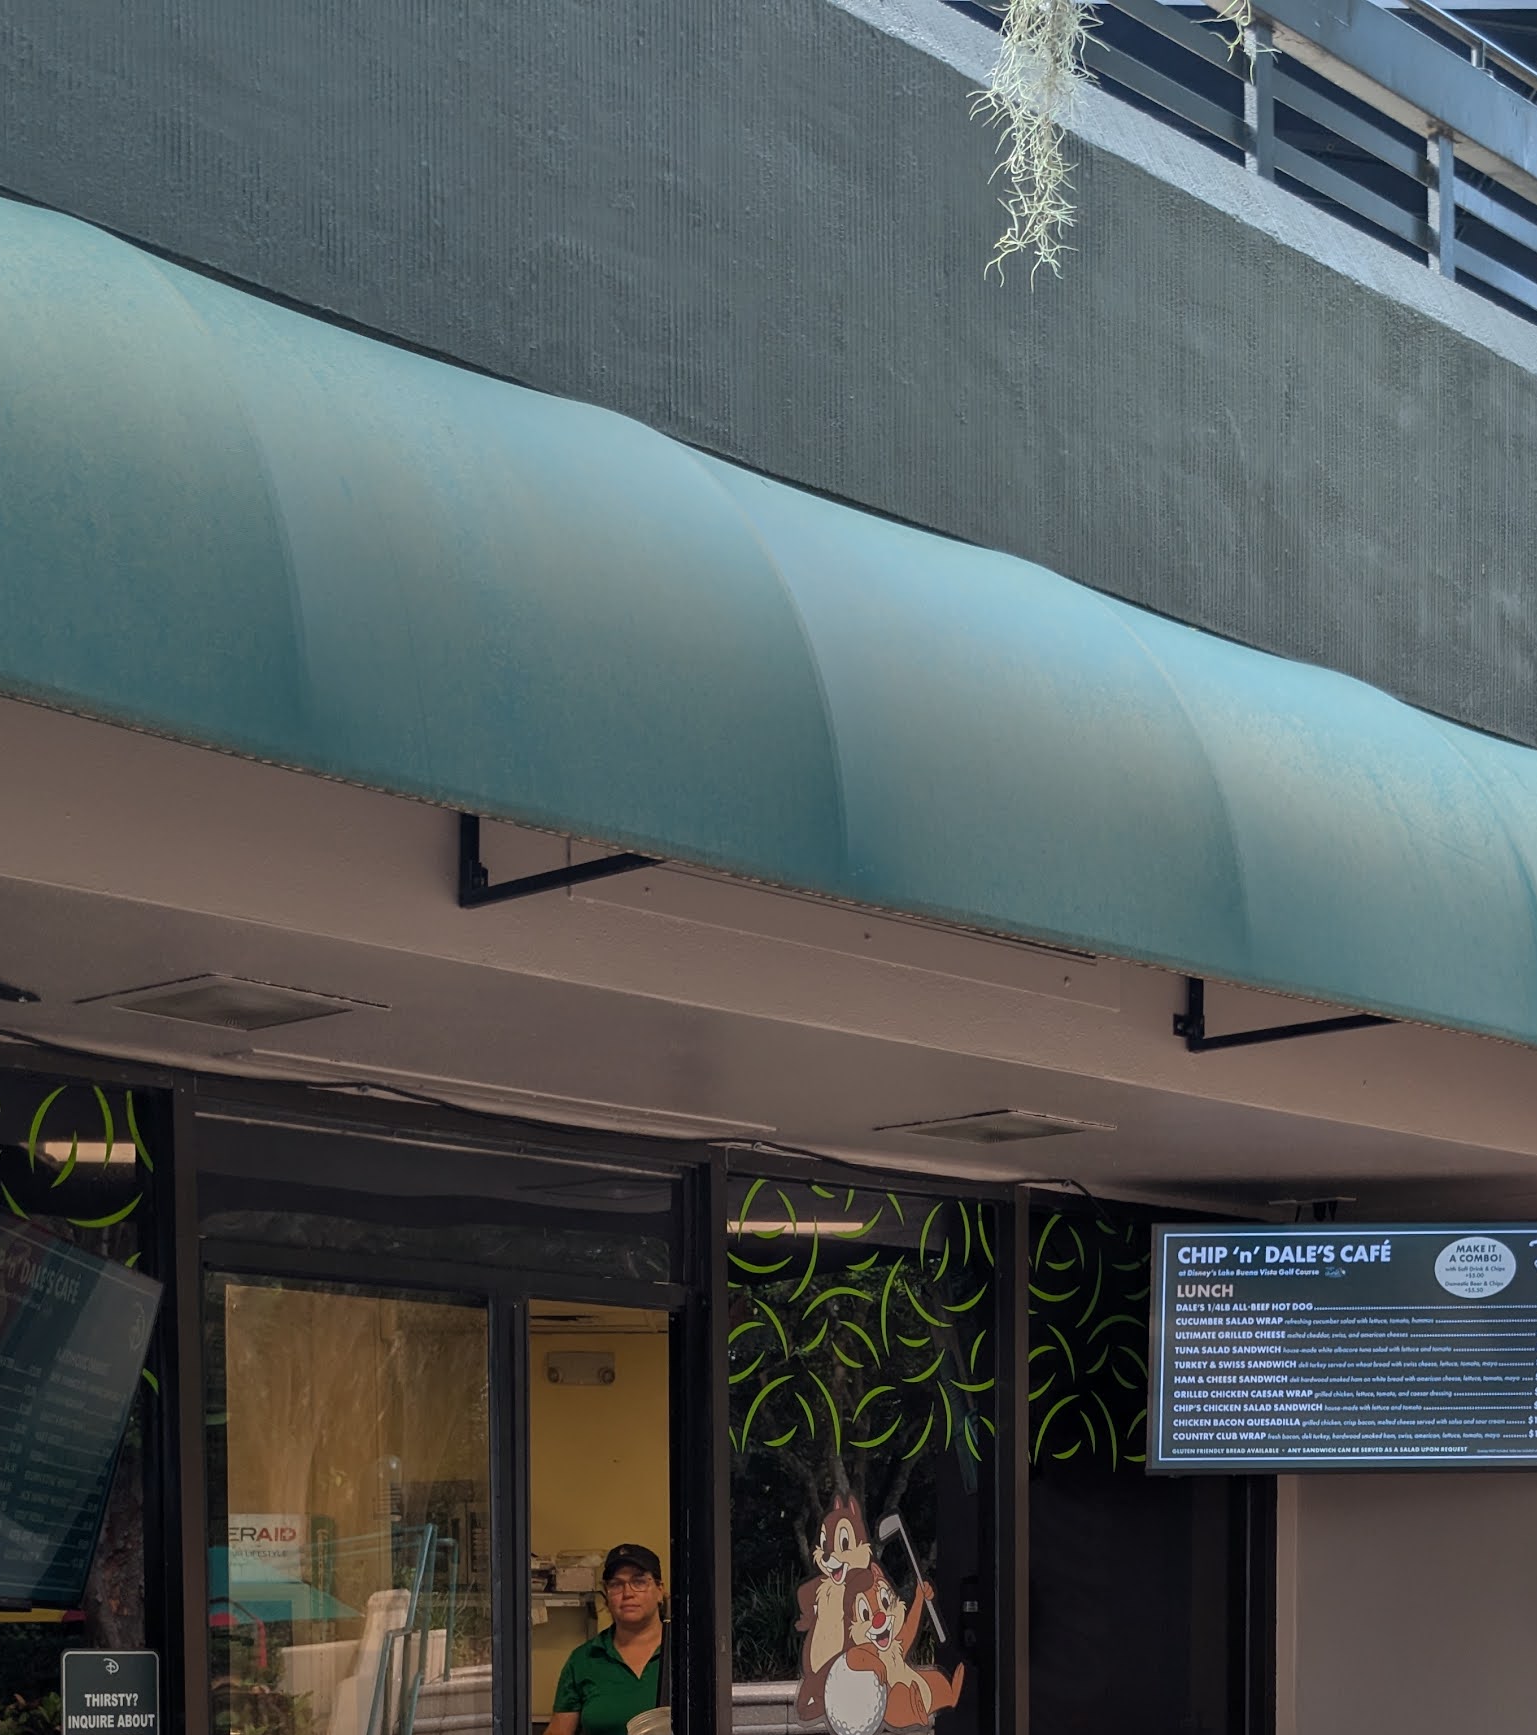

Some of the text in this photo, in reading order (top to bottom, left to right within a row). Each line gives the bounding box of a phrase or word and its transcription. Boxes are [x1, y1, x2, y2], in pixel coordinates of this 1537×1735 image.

[1178, 1247, 1227, 1264] CHIP
[1265, 1245, 1334, 1263] DALE'S
[1340, 1239, 1391, 1262] CAFÉ
[1456, 1245, 1497, 1253] MAKE IT
[1449, 1254, 1502, 1263] A COMBO!
[1279, 1268, 1294, 1276] Golf
[1177, 1284, 1234, 1298] LUNCH
[1176, 1304, 1205, 1312] DALE'S
[1207, 1303, 1230, 1313] 1/4LB
[1272, 1303, 1290, 1311] HOT
[1292, 1303, 1313, 1311] DOG
[1226, 1317, 1254, 1325] SALAD
[1256, 1317, 1283, 1325] WRAP
[1176, 1331, 1216, 1339] ULTIMATE
[1218, 1331, 1253, 1339] GRILLED
[1255, 1331, 1286, 1339] CHEESE
[1175, 1346, 1199, 1354] TUNA
[1202, 1346, 1230, 1354] SALAD
[1232, 1346, 1281, 1354] SANDWICH
[1175, 1361, 1207, 1369] TURKEY
[1210, 1361, 1216, 1369] &
[1218, 1361, 1245, 1369] SWISS
[1247, 1360, 1296, 1368] SANDWICH
[1174, 1376, 1196, 1384] HAM
[1197, 1376, 1204, 1384] &
[1239, 1375, 1288, 1383] SANDWICH
[1174, 1390, 1208, 1398] GRILLED
[1210, 1390, 1248, 1398] CHICKEN
[1251, 1390, 1284, 1398] CAESAR
[1174, 1404, 1201, 1412] CHIP'S
[1203, 1404, 1241, 1412] CHICKEN
[1243, 1404, 1272, 1412] SALAD
[1274, 1403, 1322, 1411] SANDWICH
[1173, 1419, 1211, 1427] CHICKEN
[1213, 1419, 1245, 1427] BACON
[1246, 1418, 1300, 1427] QUESADILLA
[1173, 1432, 1214, 1440] COUNTRY
[1216, 1432, 1238, 1440] CLUB
[1240, 1432, 1266, 1440] WRAP
[85, 1693, 138, 1707] THIRSTY?
[68, 1714, 155, 1729] INQUIRE ABOUT
